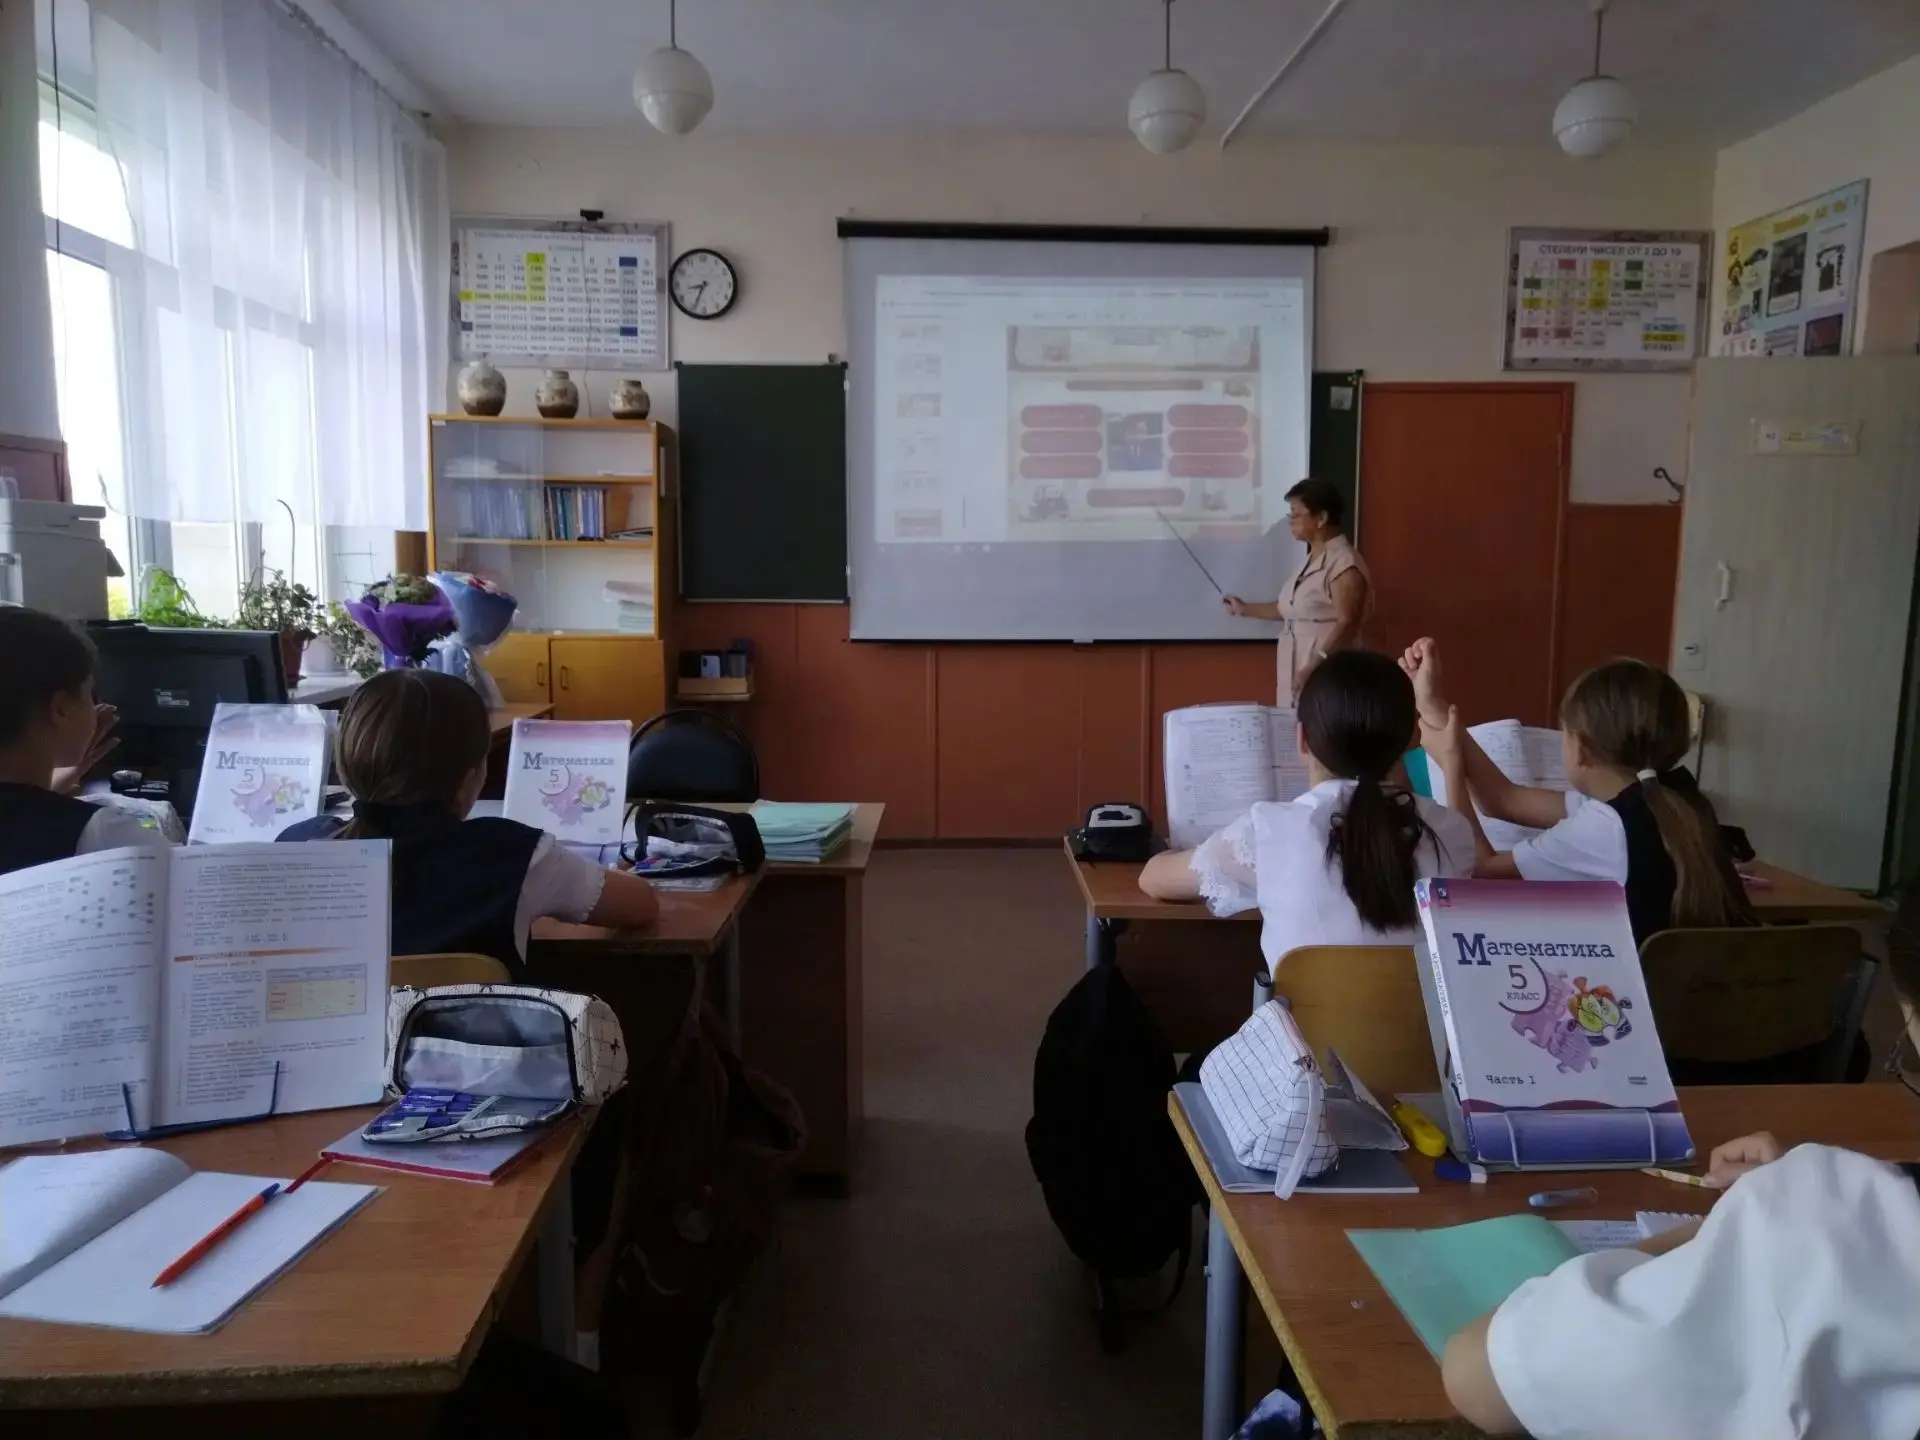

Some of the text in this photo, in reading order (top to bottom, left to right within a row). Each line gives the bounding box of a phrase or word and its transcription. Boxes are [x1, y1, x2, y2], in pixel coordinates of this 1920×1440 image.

[1539, 244, 1588, 256] СТЕПЕНИ
[1590, 245, 1625, 257] ЧИСЕЛ
[1627, 246, 1642, 257] ОТ
[1652, 247, 1668, 258] ДО
[216, 751, 309, 769] Математика
[523, 751, 614, 770] Математика
[242, 769, 254, 783] 5
[549, 769, 561, 783] 5
[1452, 932, 1616, 966] Математика
[1508, 964, 1528, 990] 5
[1506, 990, 1541, 1002] КЛАСС
[1486, 1074, 1536, 1086] Часть 1
